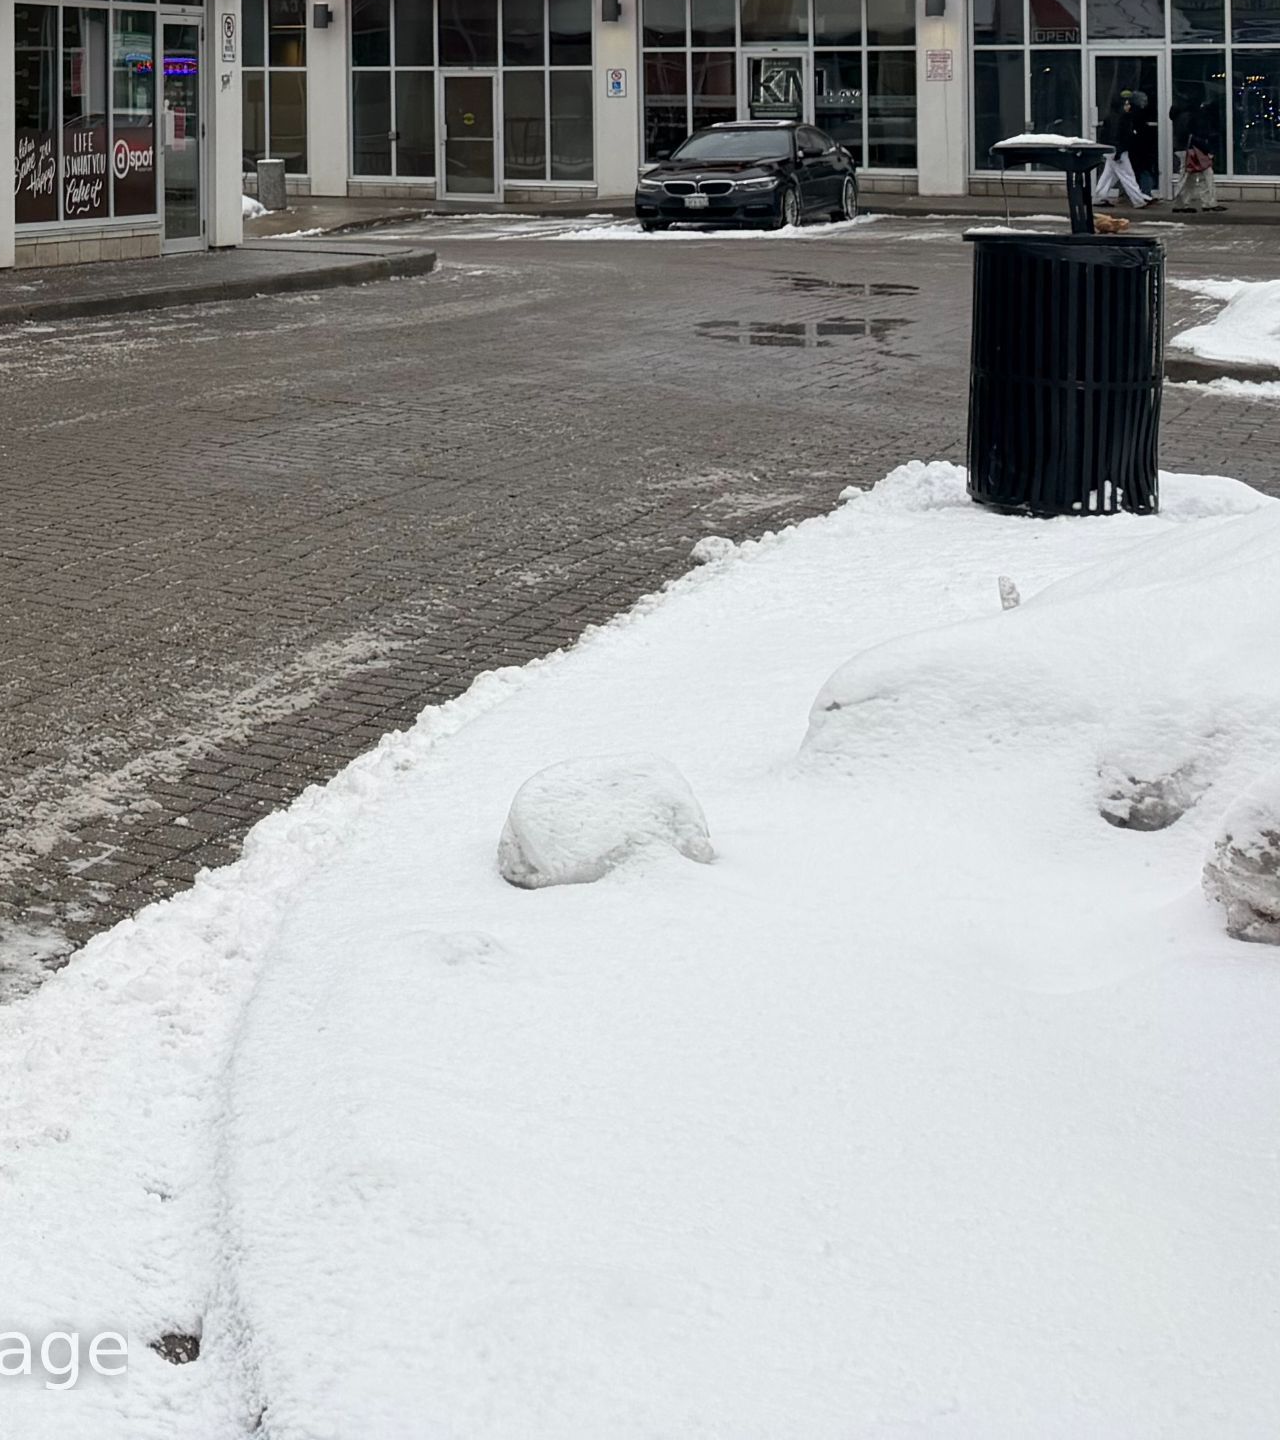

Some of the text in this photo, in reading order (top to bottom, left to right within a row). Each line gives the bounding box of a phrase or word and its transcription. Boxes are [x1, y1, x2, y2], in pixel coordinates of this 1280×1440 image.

[1034, 30, 1078, 42] OPEN
[73, 131, 94, 153] LIFE
[129, 145, 154, 172] spot
